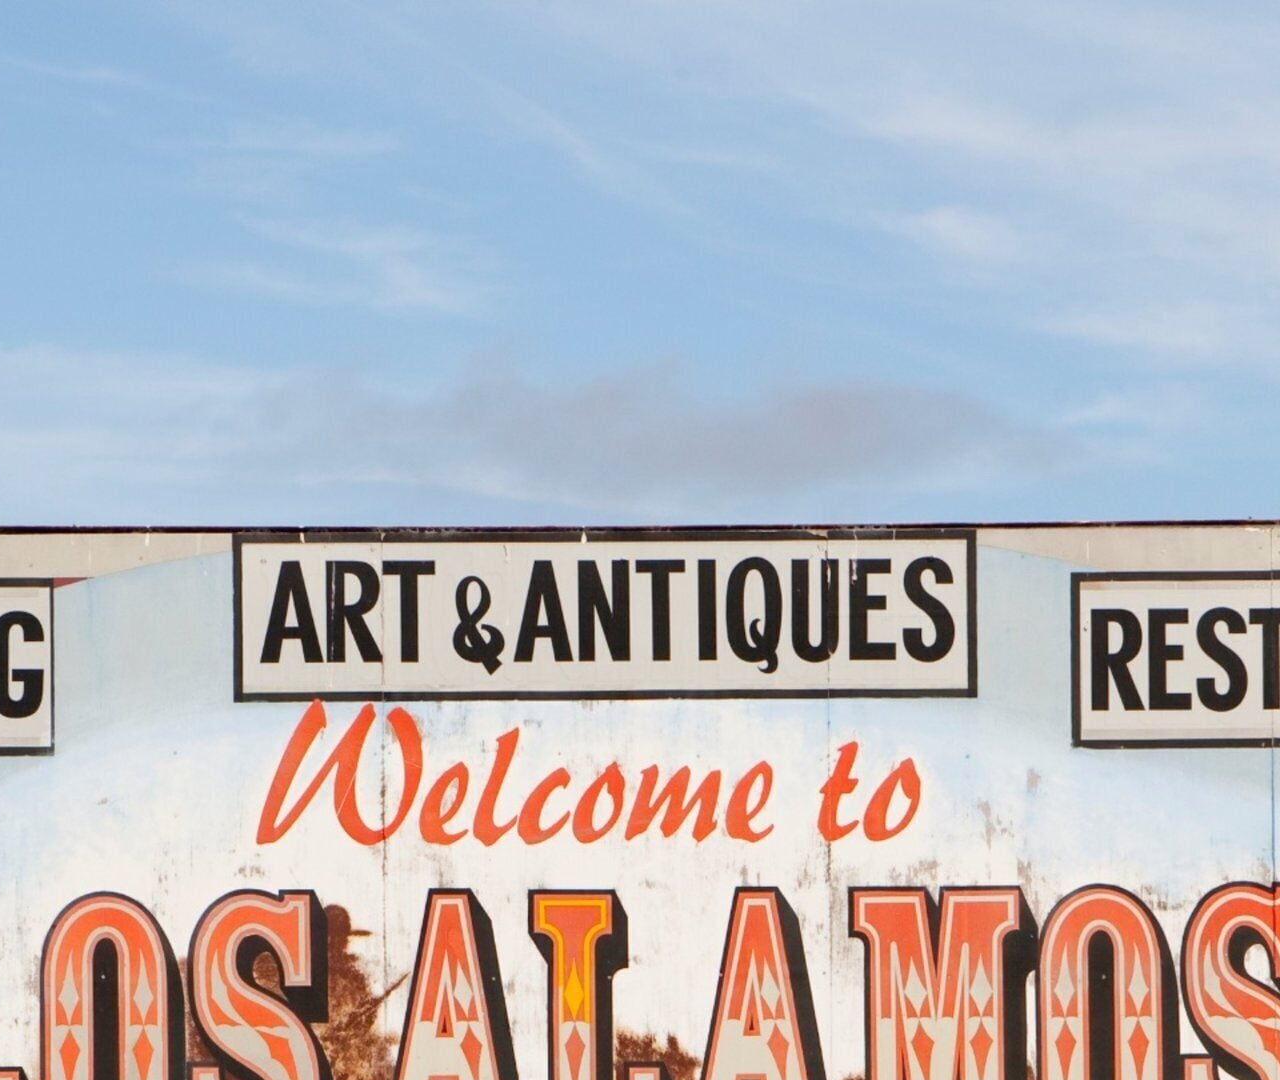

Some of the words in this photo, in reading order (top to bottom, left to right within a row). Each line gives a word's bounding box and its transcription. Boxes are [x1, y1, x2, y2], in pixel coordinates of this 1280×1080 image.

[261, 560, 435, 664] ART
[453, 576, 505, 674] &
[514, 557, 955, 674] ANTIQUES
[256, 698, 774, 846] Welcome
[817, 741, 921, 842] to
